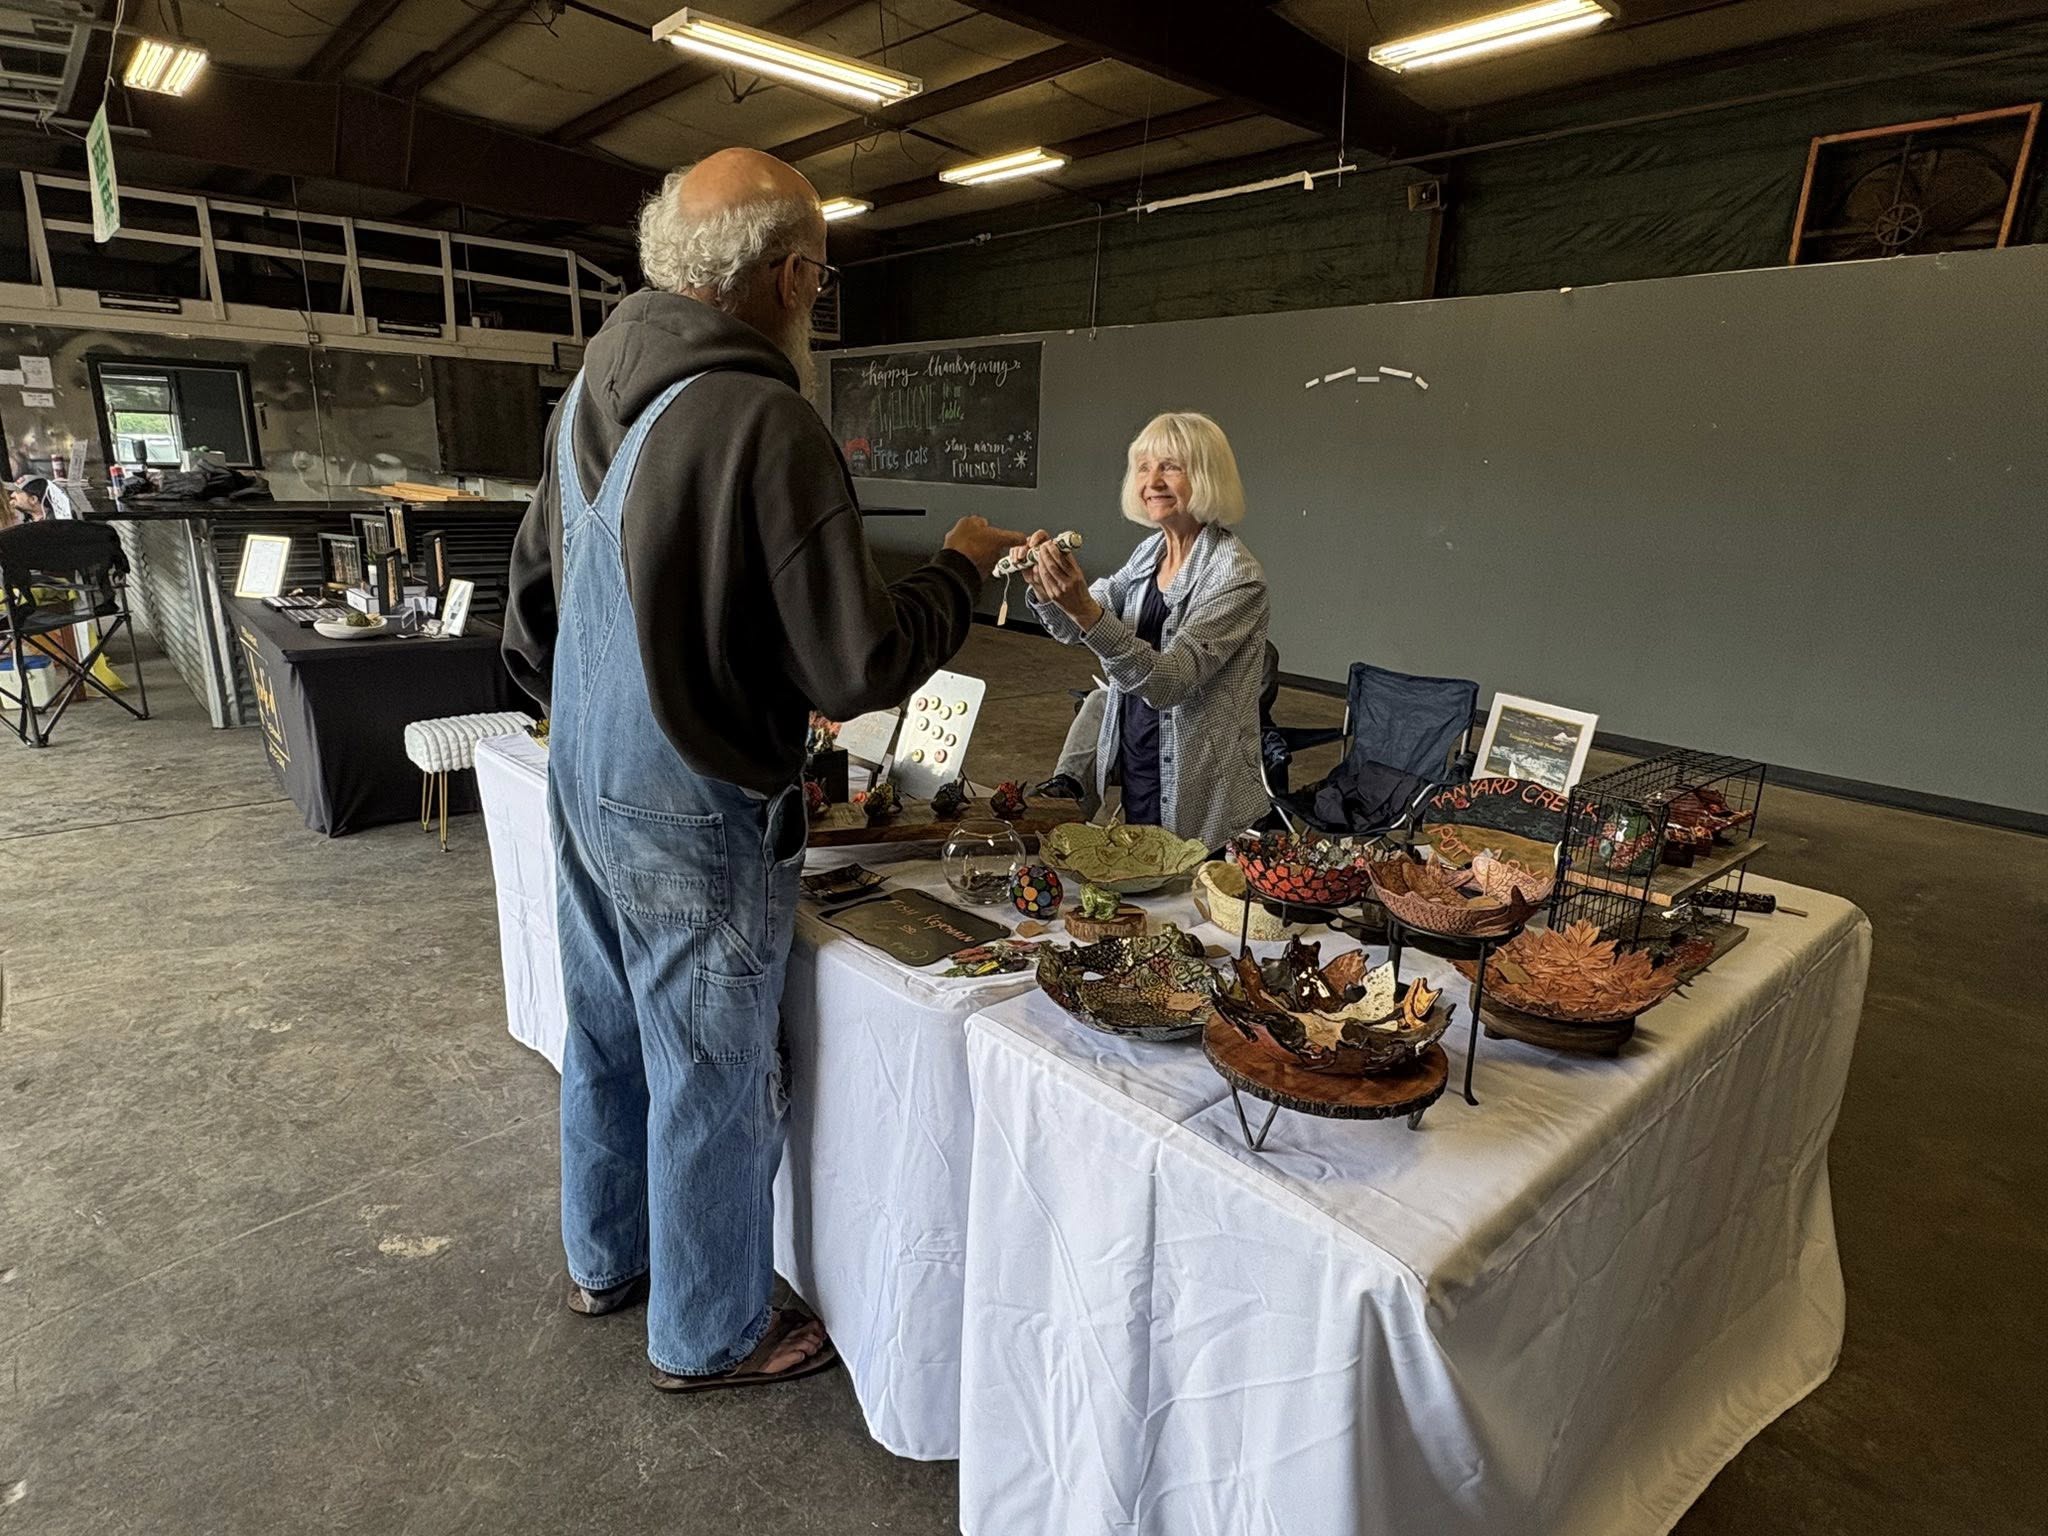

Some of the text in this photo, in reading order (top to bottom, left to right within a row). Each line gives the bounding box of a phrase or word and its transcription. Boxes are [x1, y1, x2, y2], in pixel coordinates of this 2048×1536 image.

[862, 355, 1021, 388] happy thanksgiving
[944, 438, 1011, 460] stay warm
[1429, 777, 1518, 809] TANYARD
